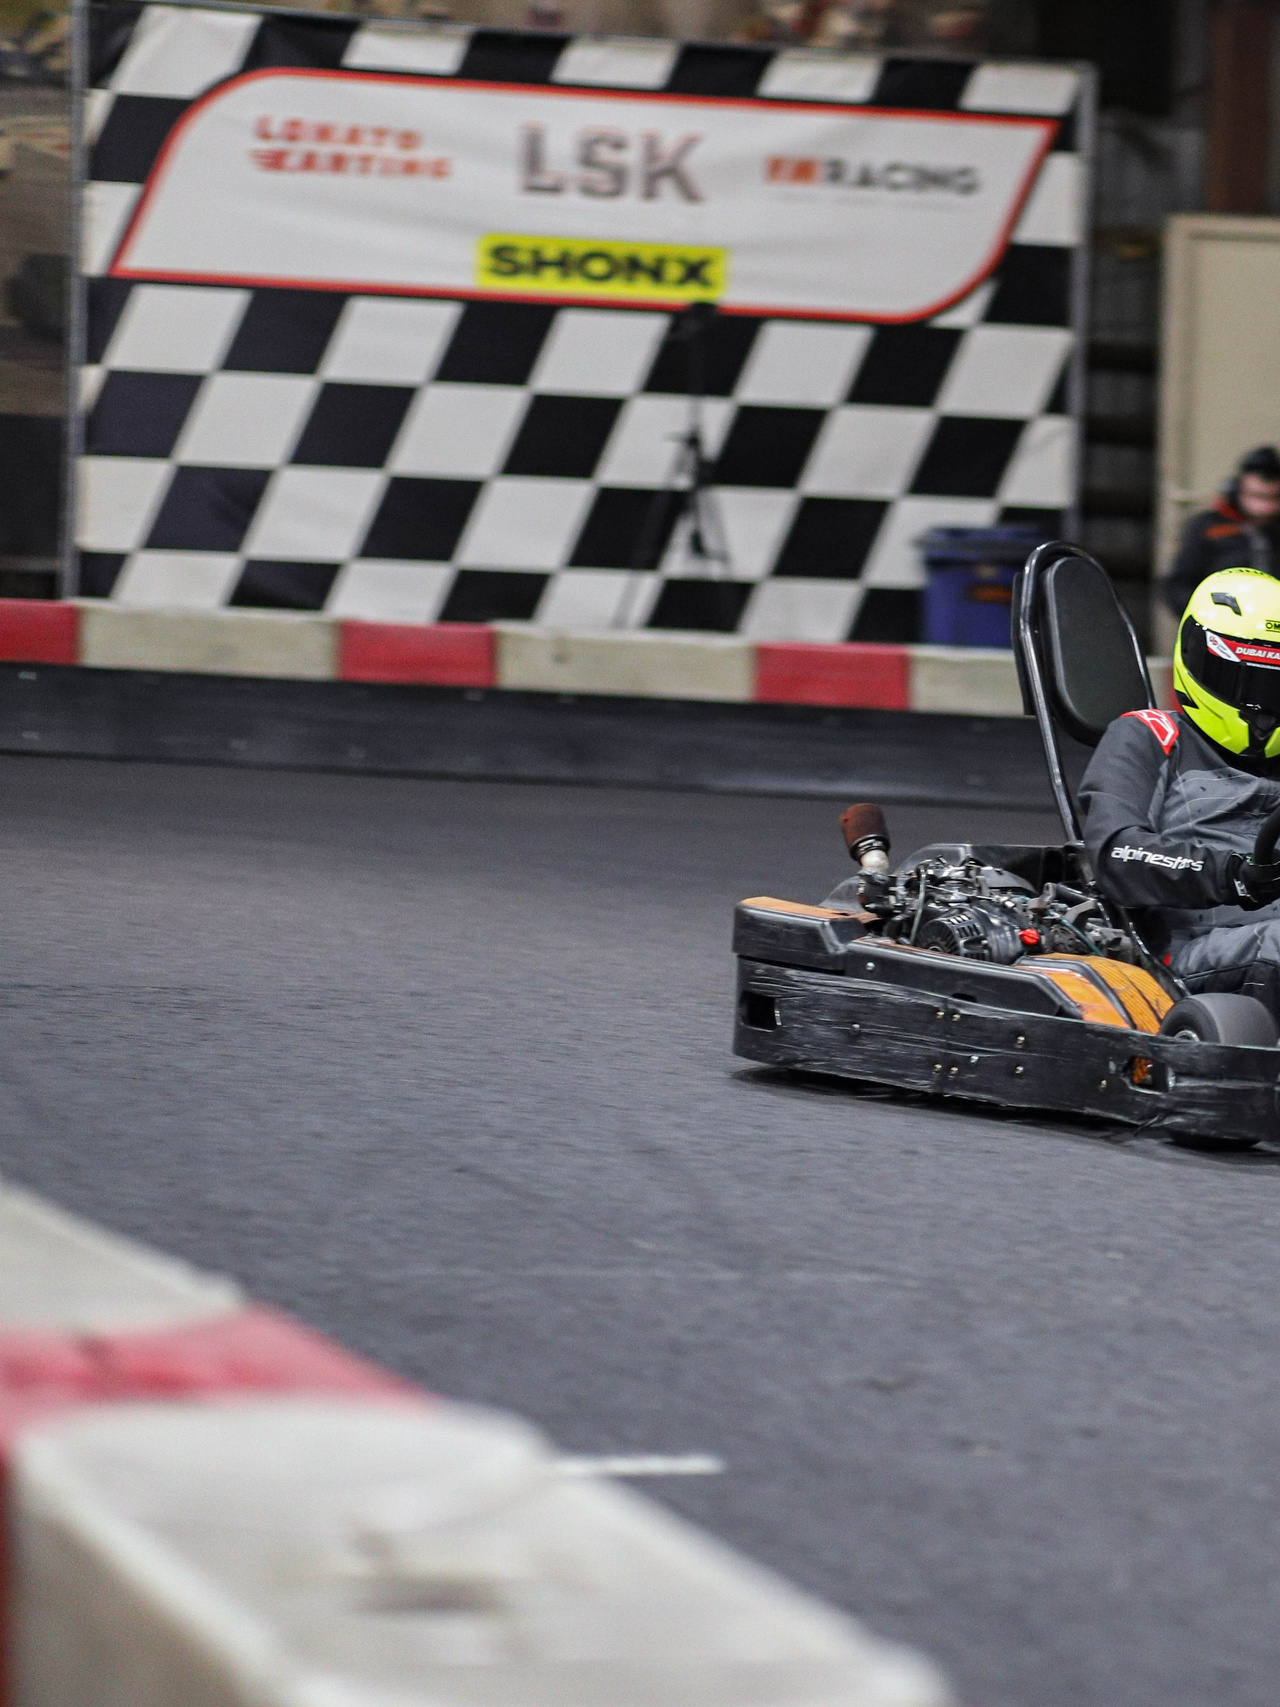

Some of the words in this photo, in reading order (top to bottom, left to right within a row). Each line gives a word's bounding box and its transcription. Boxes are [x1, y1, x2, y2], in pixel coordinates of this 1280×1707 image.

[250, 150, 454, 181] KARTING
[518, 121, 705, 204] LSK
[490, 245, 712, 287] SHONX
[1235, 647, 1266, 658] DUBAI
[1110, 845, 1205, 872] alpinestars
